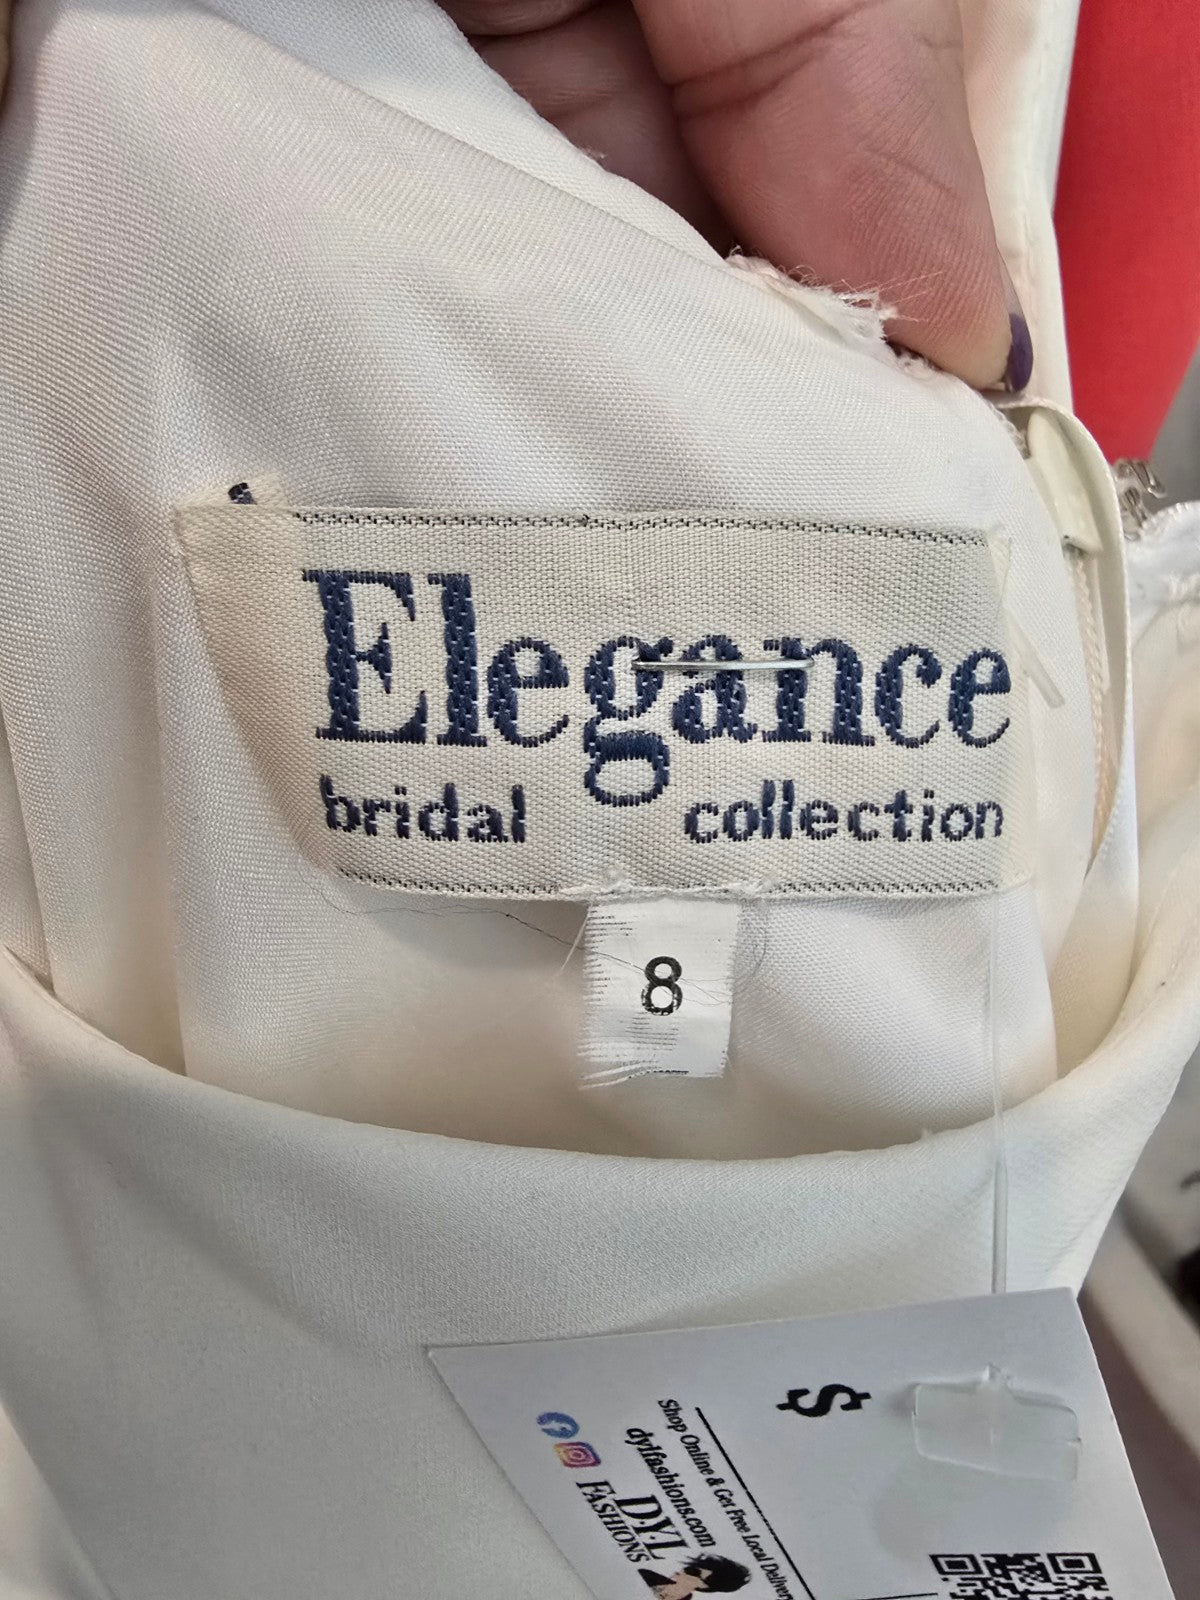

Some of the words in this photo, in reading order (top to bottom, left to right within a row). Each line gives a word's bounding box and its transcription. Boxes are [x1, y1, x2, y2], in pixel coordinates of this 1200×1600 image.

[302, 568, 1012, 808] Elegance
[318, 774, 527, 844] bridal
[684, 778, 1004, 844] collection
[639, 955, 684, 1017] 8
[657, 1399, 689, 1433] Shop
[776, 1383, 872, 1418] $
[680, 1434, 715, 1476] Online
[624, 1427, 717, 1548] dylfashions.com
[705, 1477, 726, 1488] &
[713, 1488, 737, 1509] Get
[575, 1480, 652, 1563] FASHIONS
[725, 1508, 752, 1534] Free
[741, 1534, 776, 1563] Local
[760, 1563, 795, 1600] Deliver
